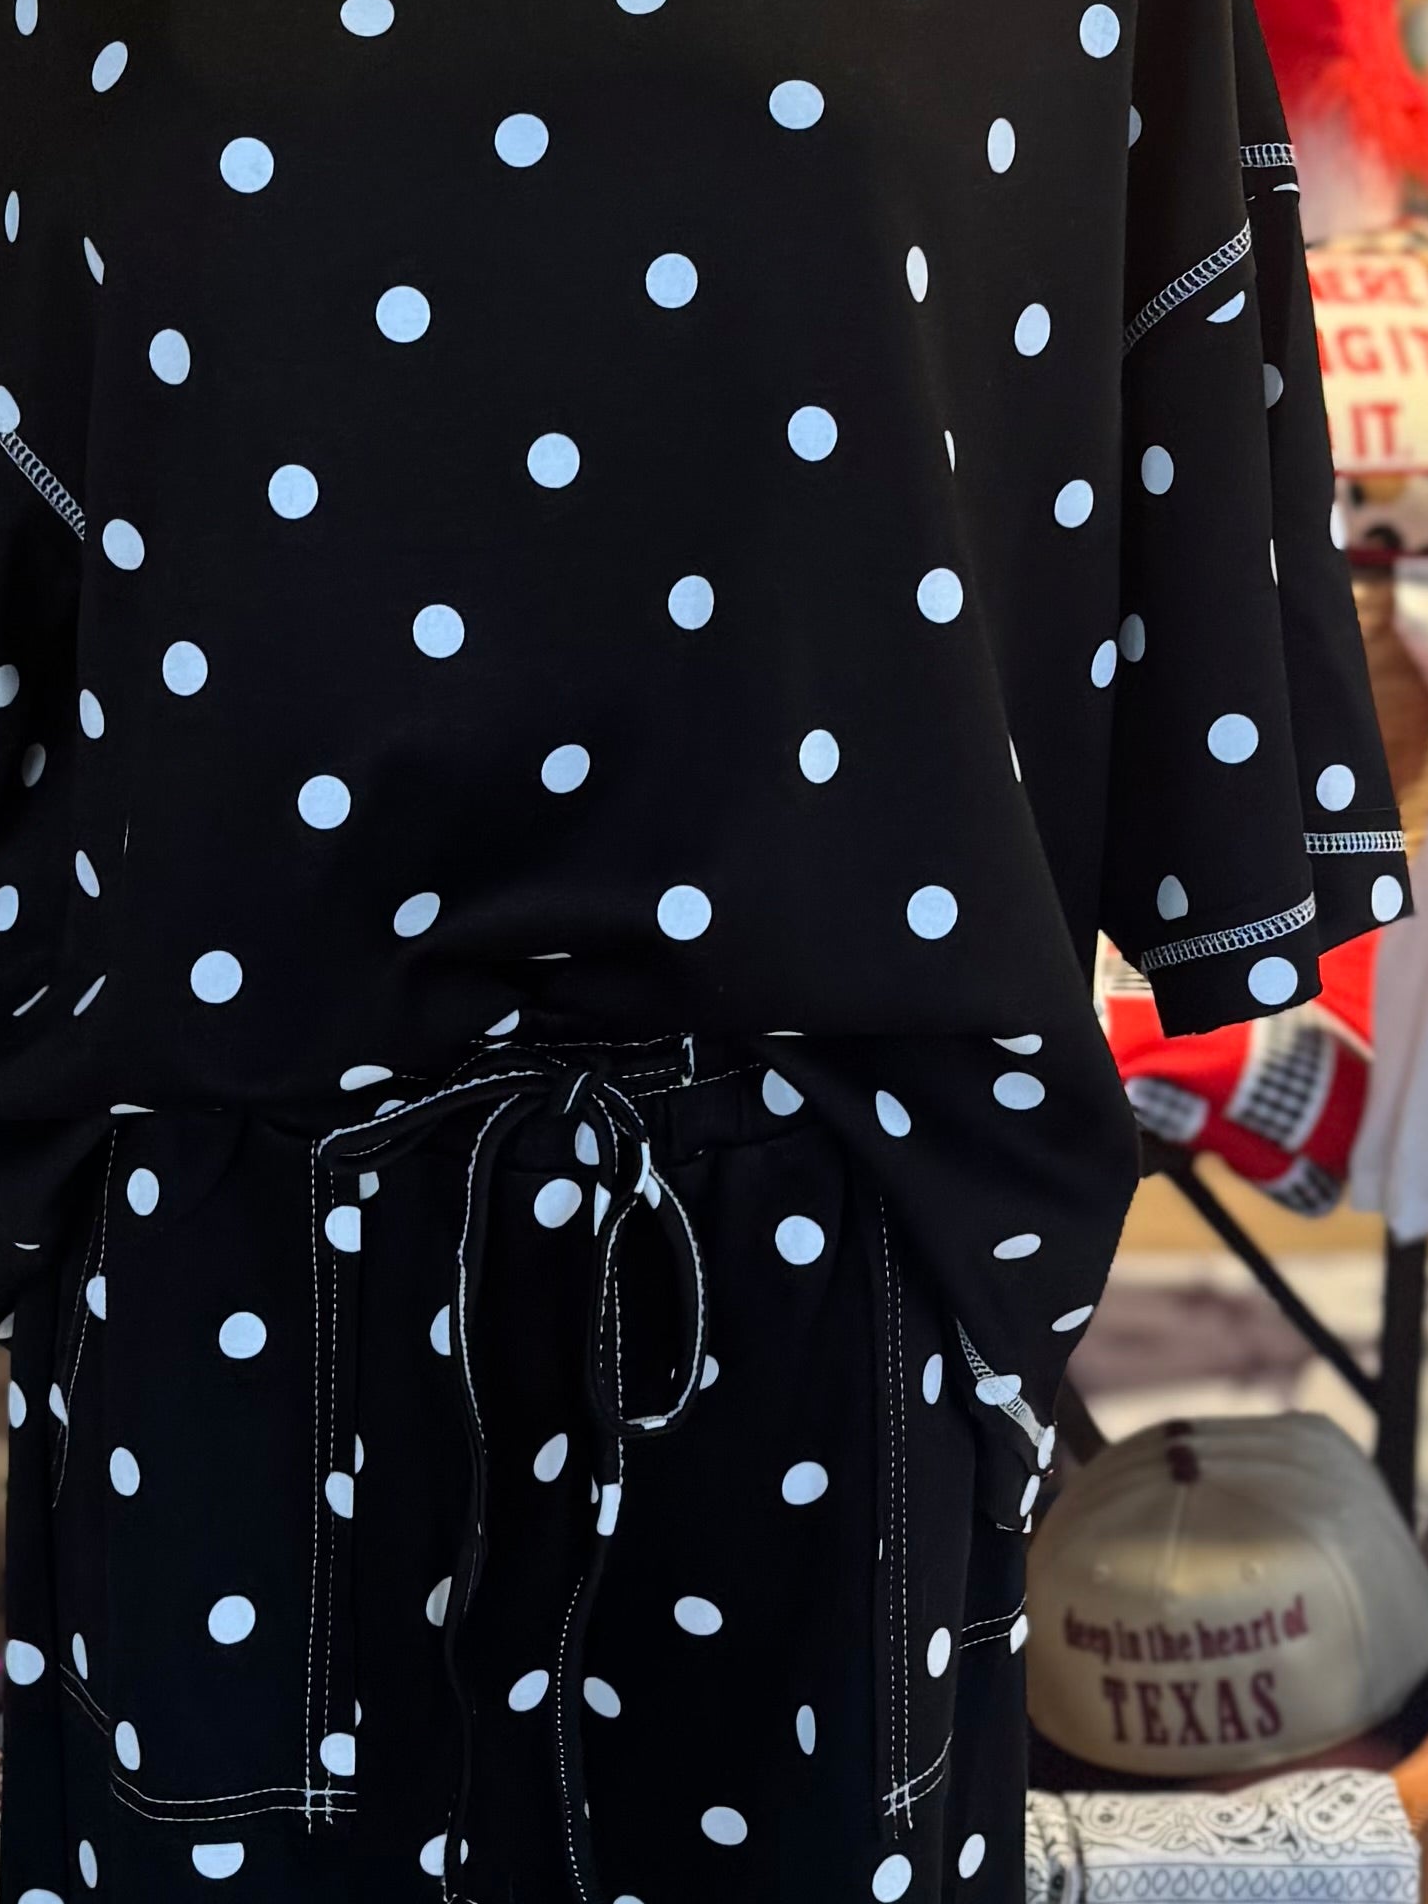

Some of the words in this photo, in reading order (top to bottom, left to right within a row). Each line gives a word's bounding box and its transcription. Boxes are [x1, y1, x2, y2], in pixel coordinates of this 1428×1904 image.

[1145, 1620, 1193, 1665] the
[1194, 1608, 1279, 1662] heart
[1101, 1668, 1284, 1747] TEXAS
